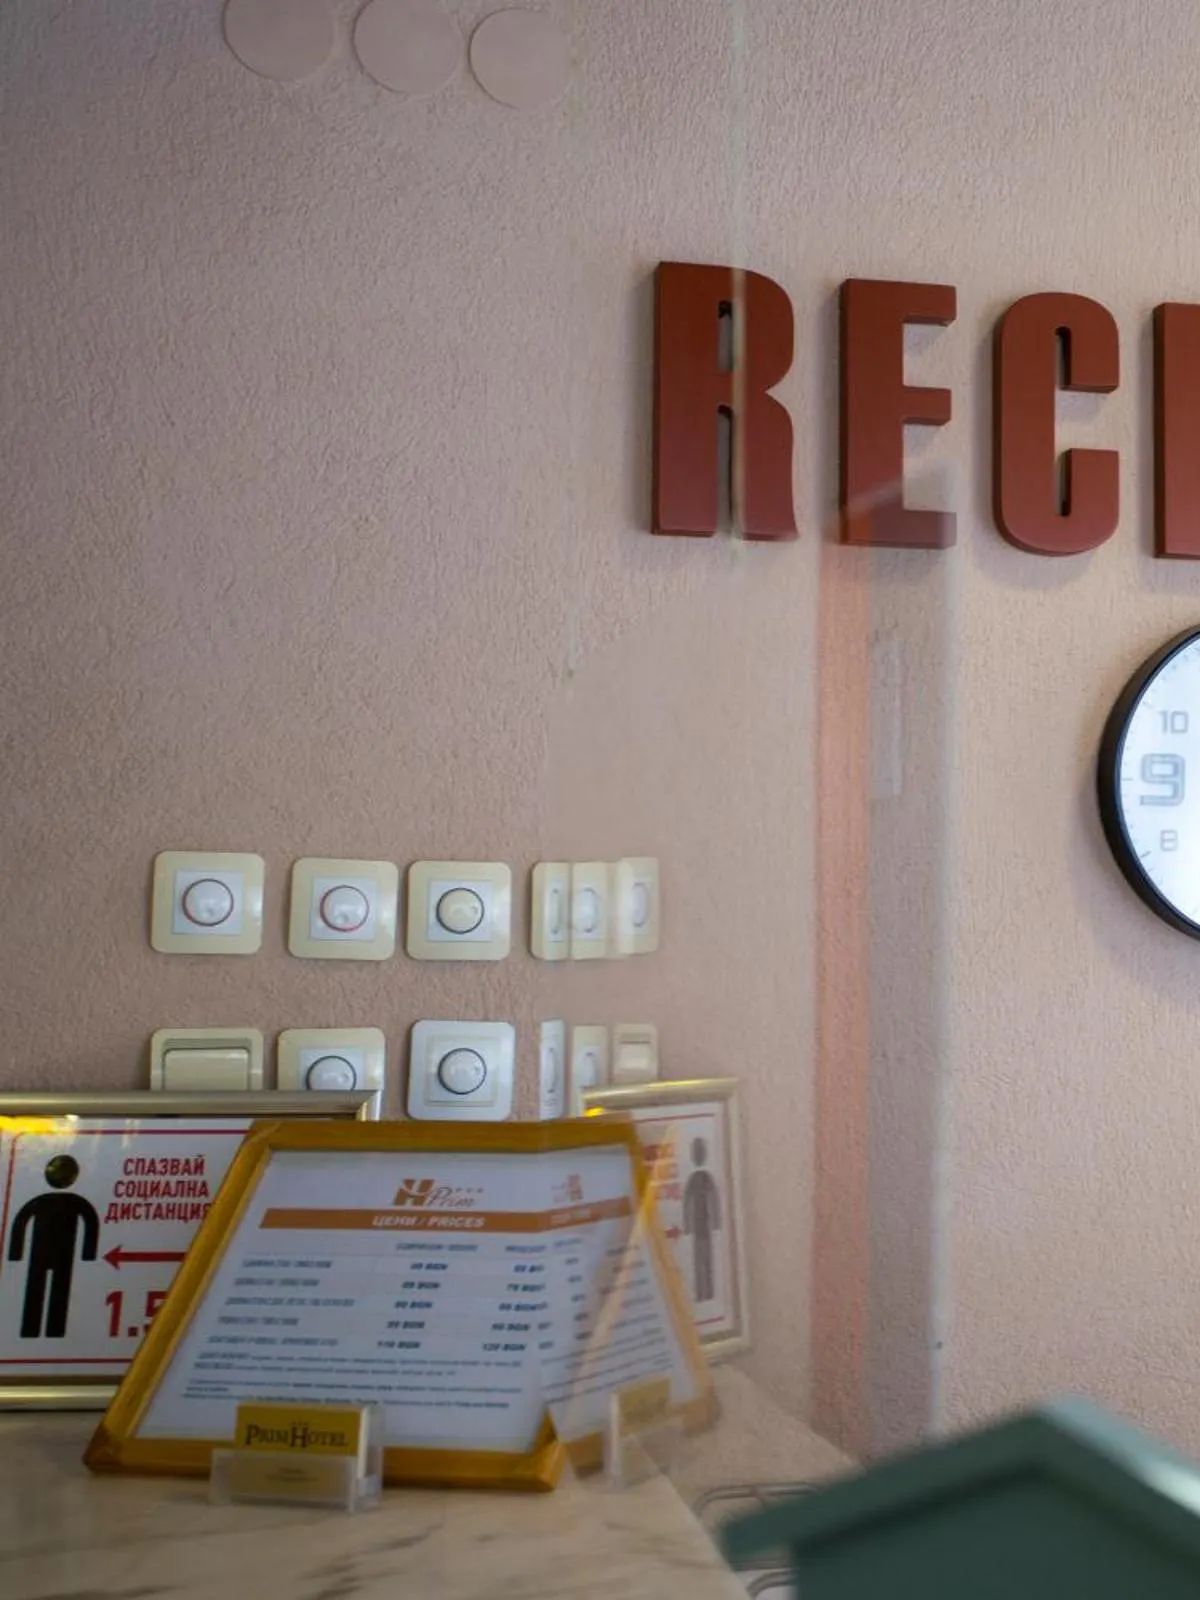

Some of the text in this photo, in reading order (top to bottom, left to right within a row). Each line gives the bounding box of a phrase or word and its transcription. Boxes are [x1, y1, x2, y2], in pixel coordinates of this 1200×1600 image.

[1159, 710, 1190, 735] 10
[1139, 753, 1186, 807] 9
[1159, 829, 1179, 852] 8
[123, 1154, 206, 1177] СПАЗВАЙ
[114, 1180, 210, 1200] СОЦИАЛНА
[104, 1202, 213, 1224] ДИСТАНЦИЯ
[427, 1215, 486, 1228] PRICES
